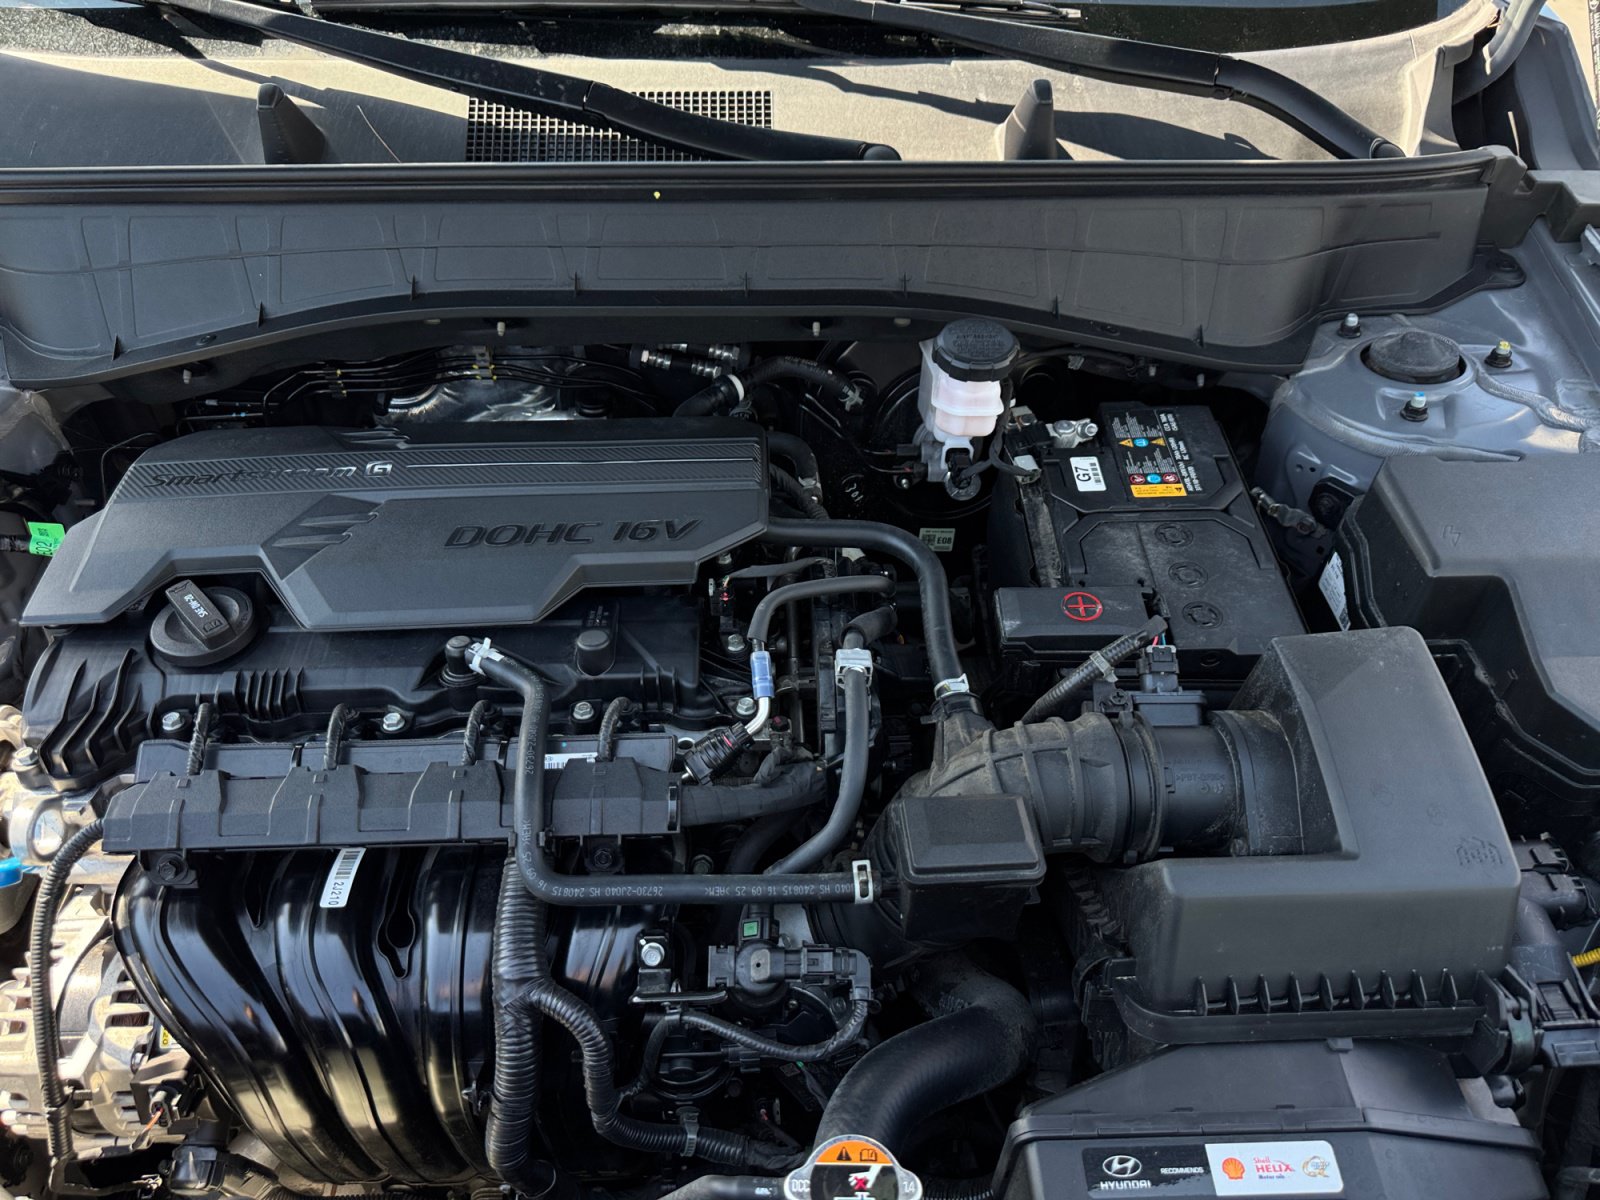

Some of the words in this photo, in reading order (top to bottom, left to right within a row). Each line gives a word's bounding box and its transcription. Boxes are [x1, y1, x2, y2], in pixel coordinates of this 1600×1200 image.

[1074, 466, 1092, 482] G7
[444, 522, 601, 549] DOHC
[612, 519, 702, 541] 16V
[522, 851, 532, 863] 25
[527, 867, 537, 879] 09
[538, 879, 548, 891] 16
[782, 885, 815, 895] 240815
[819, 884, 830, 894] HS
[328, 881, 345, 906] 2J210
[551, 886, 585, 897] 240815
[589, 887, 601, 896] HS
[605, 886, 663, 897] 26730-2J040
[735, 886, 746, 896] 25
[752, 886, 762, 895] 09
[767, 886, 777, 895] 16
[1253, 1156, 1271, 1164] Shell
[1160, 1167, 1205, 1175] RECOMMENDS
[1255, 1164, 1293, 1173] HELIX
[1100, 1180, 1152, 1190] HYUNDAI
